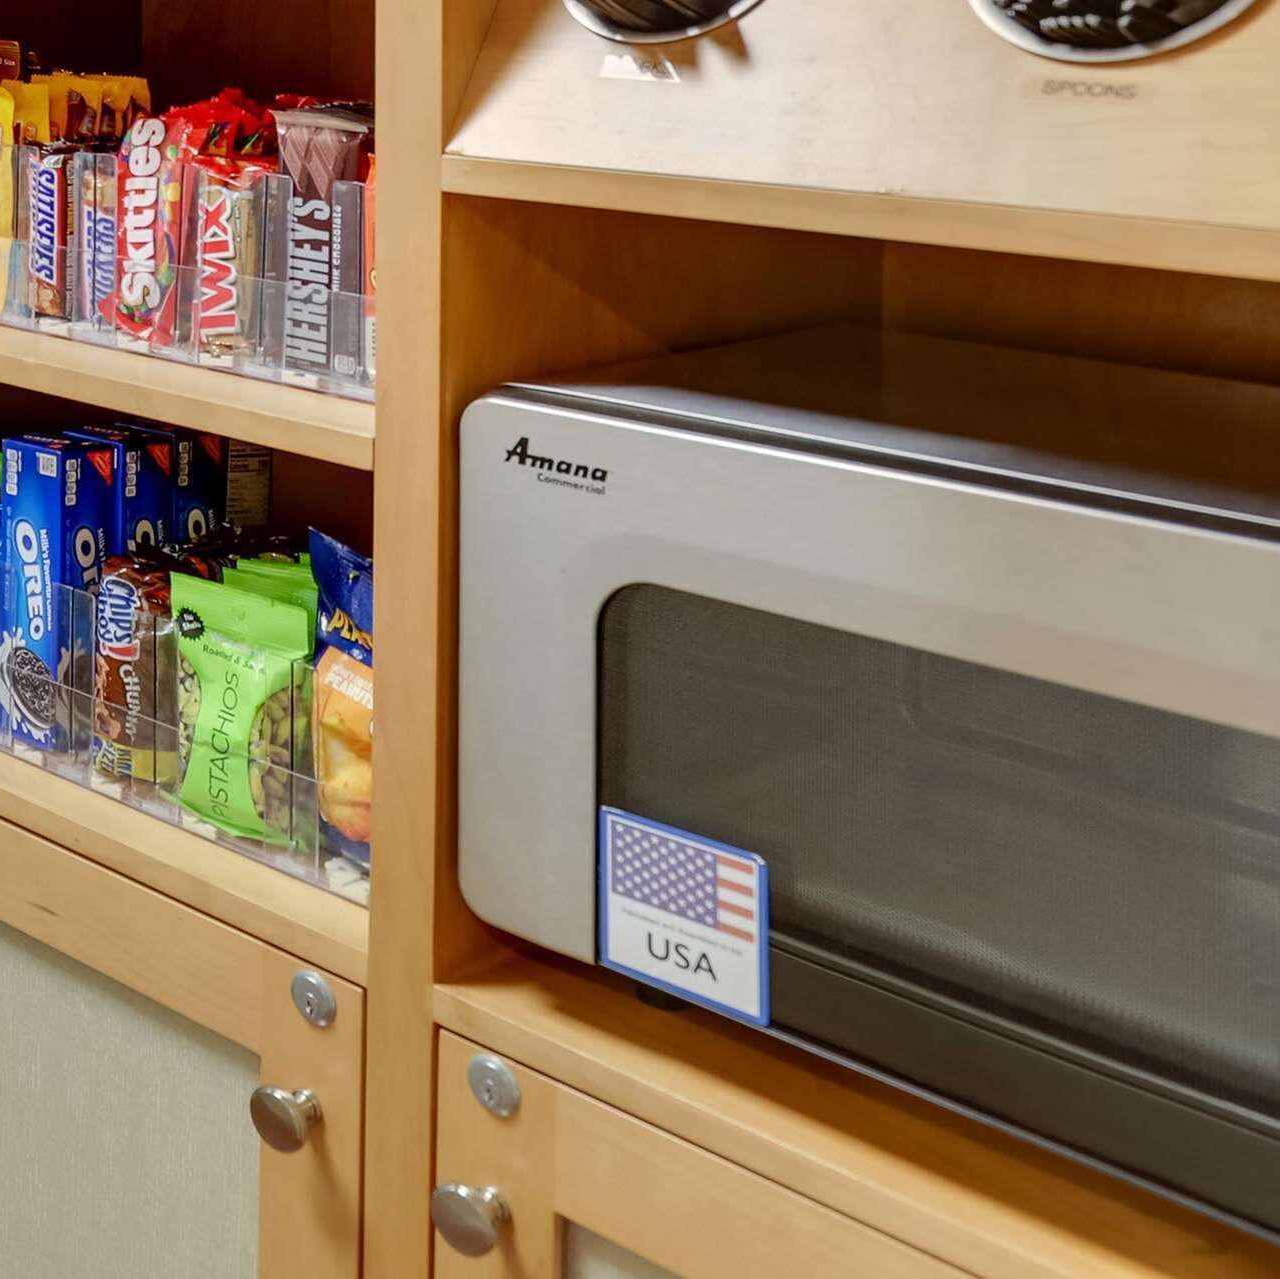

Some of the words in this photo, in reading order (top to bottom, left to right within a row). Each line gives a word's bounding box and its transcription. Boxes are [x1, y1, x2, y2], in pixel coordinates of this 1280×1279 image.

[1040, 79, 1138, 101] SPOONS
[198, 196, 238, 342] TWIX
[285, 197, 331, 365] HERSHEY'S
[505, 436, 609, 483] Amana
[536, 472, 607, 496] Commercial
[13, 517, 45, 642] OREO
[207, 671, 241, 819] PISTACHIOS
[646, 932, 718, 983] USA
